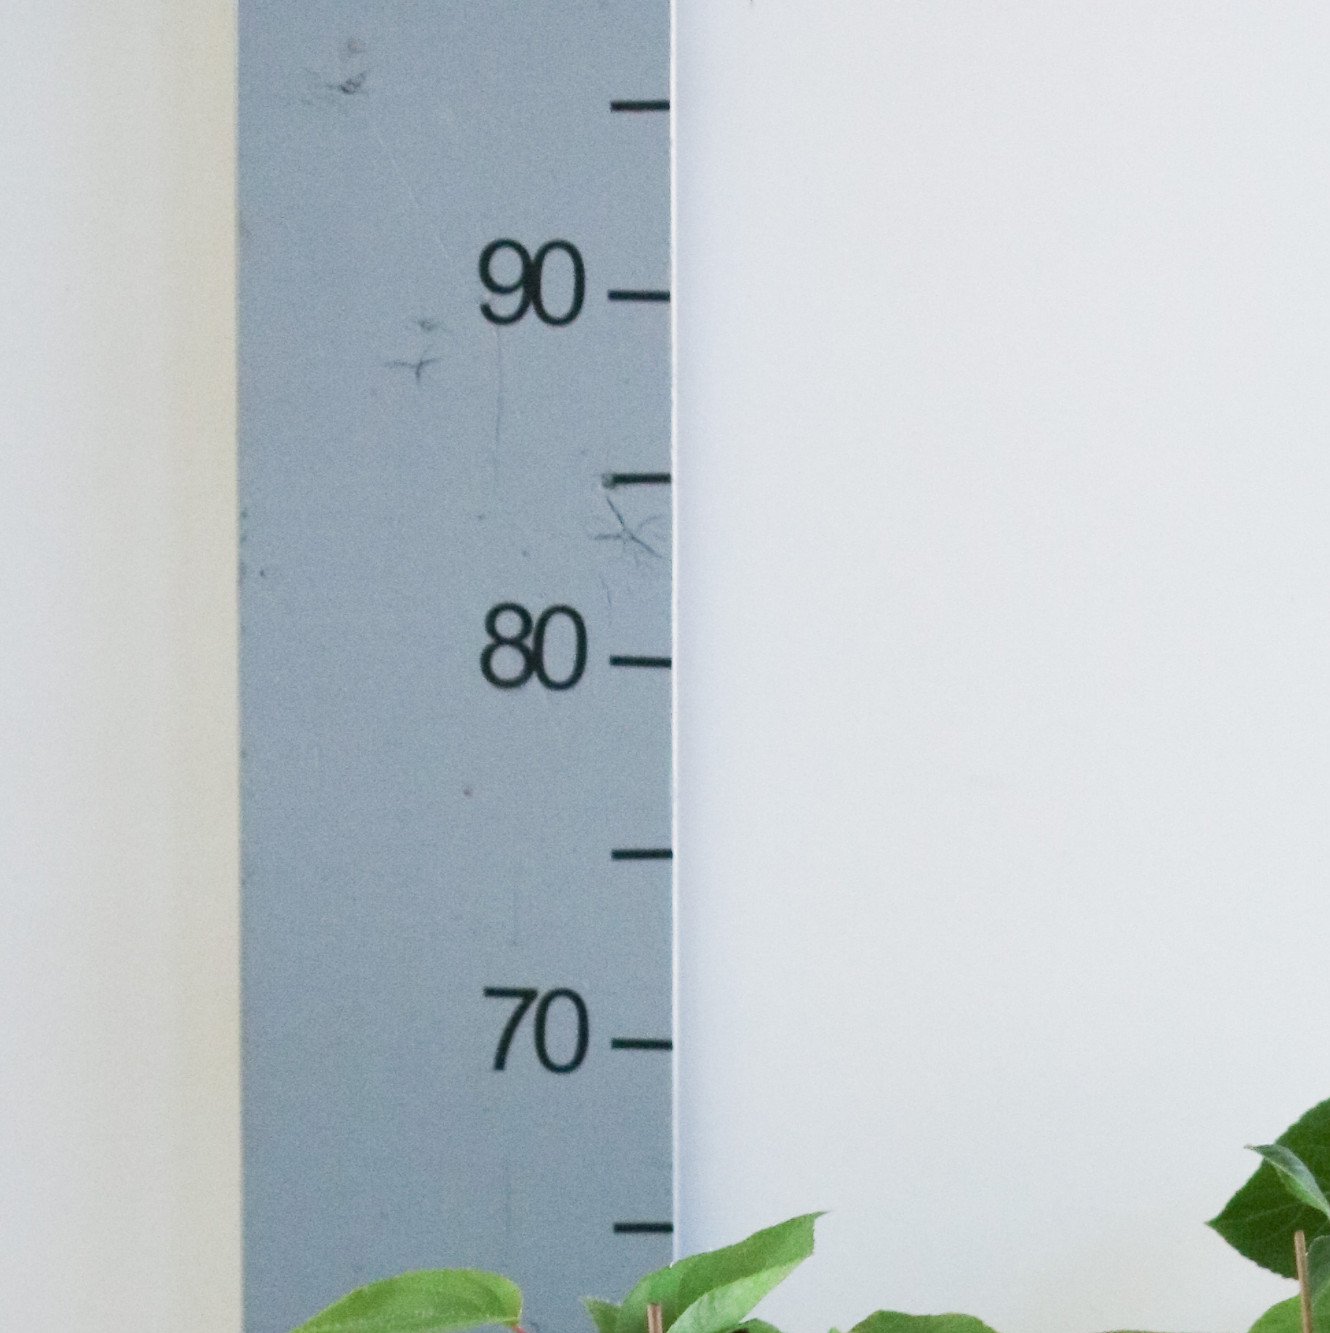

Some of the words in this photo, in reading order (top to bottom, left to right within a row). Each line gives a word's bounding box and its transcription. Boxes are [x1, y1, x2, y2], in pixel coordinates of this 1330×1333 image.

[478, 238, 586, 327] 90
[479, 602, 588, 692] 80
[483, 987, 590, 1074] 70
